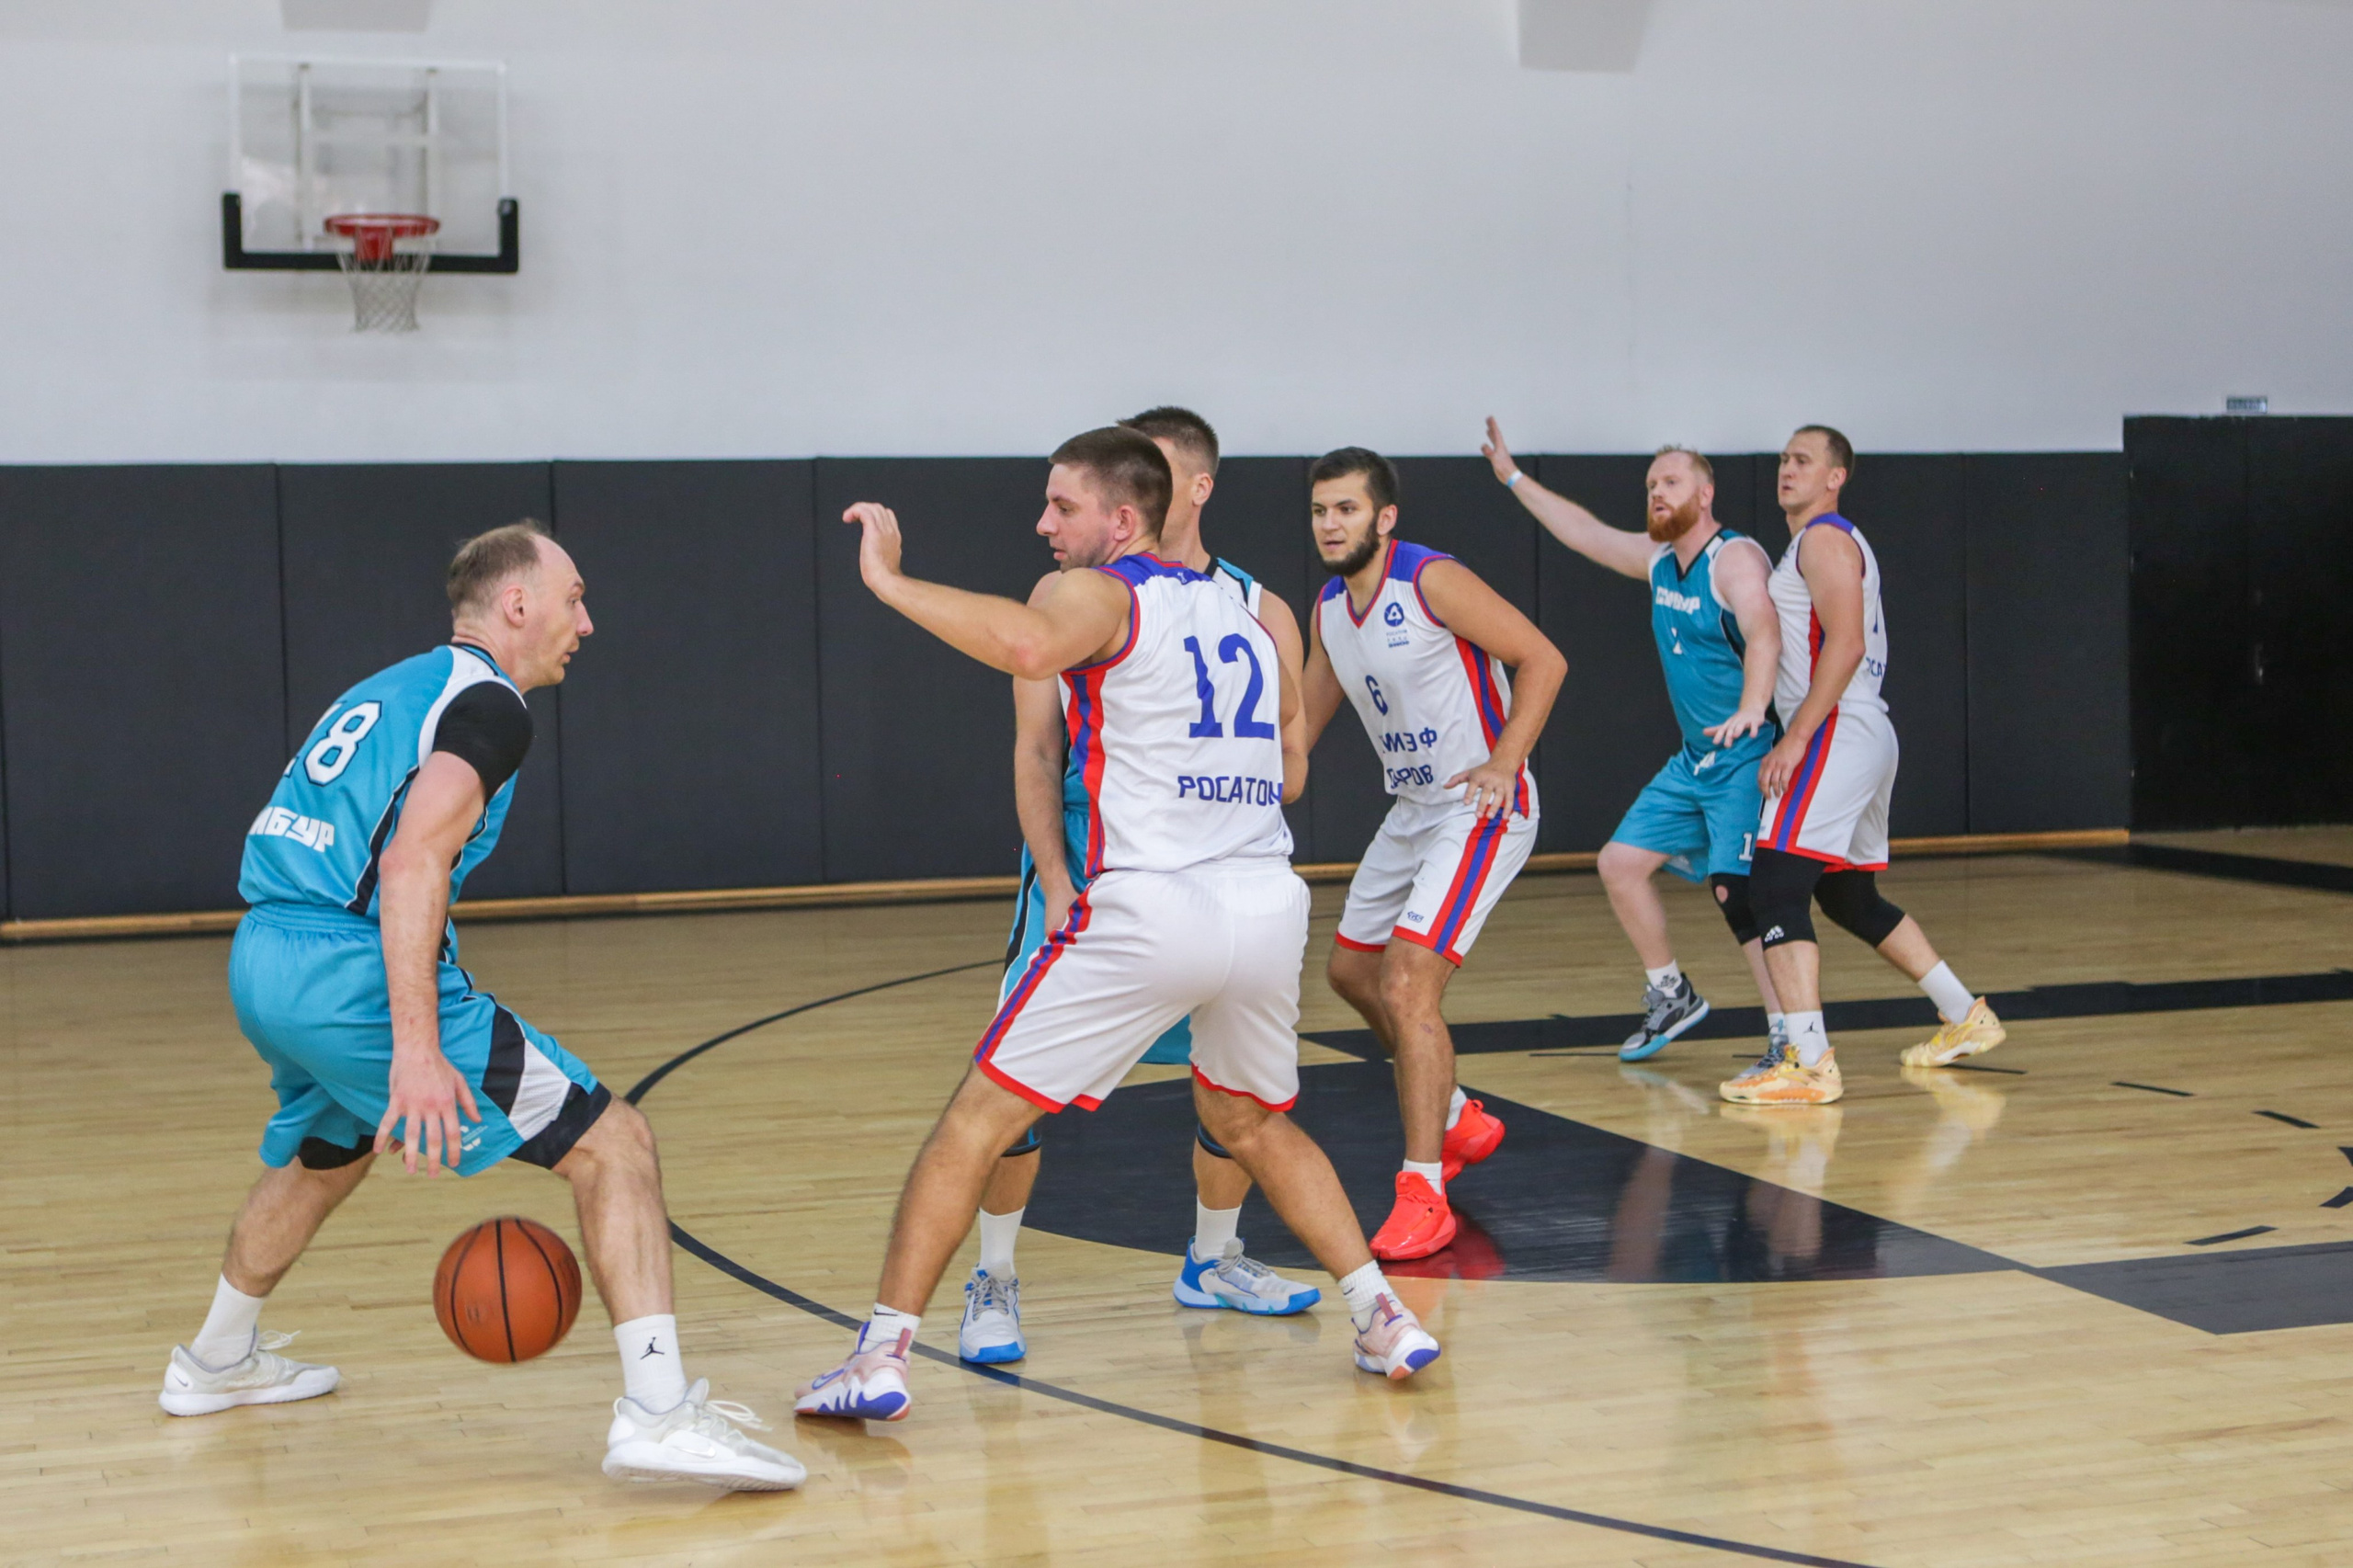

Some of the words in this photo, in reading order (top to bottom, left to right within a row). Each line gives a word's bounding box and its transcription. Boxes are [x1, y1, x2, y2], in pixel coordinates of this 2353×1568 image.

[1183, 633, 1275, 741] 12
[1365, 675, 1389, 716] 6
[247, 806, 335, 853] ИБУР
